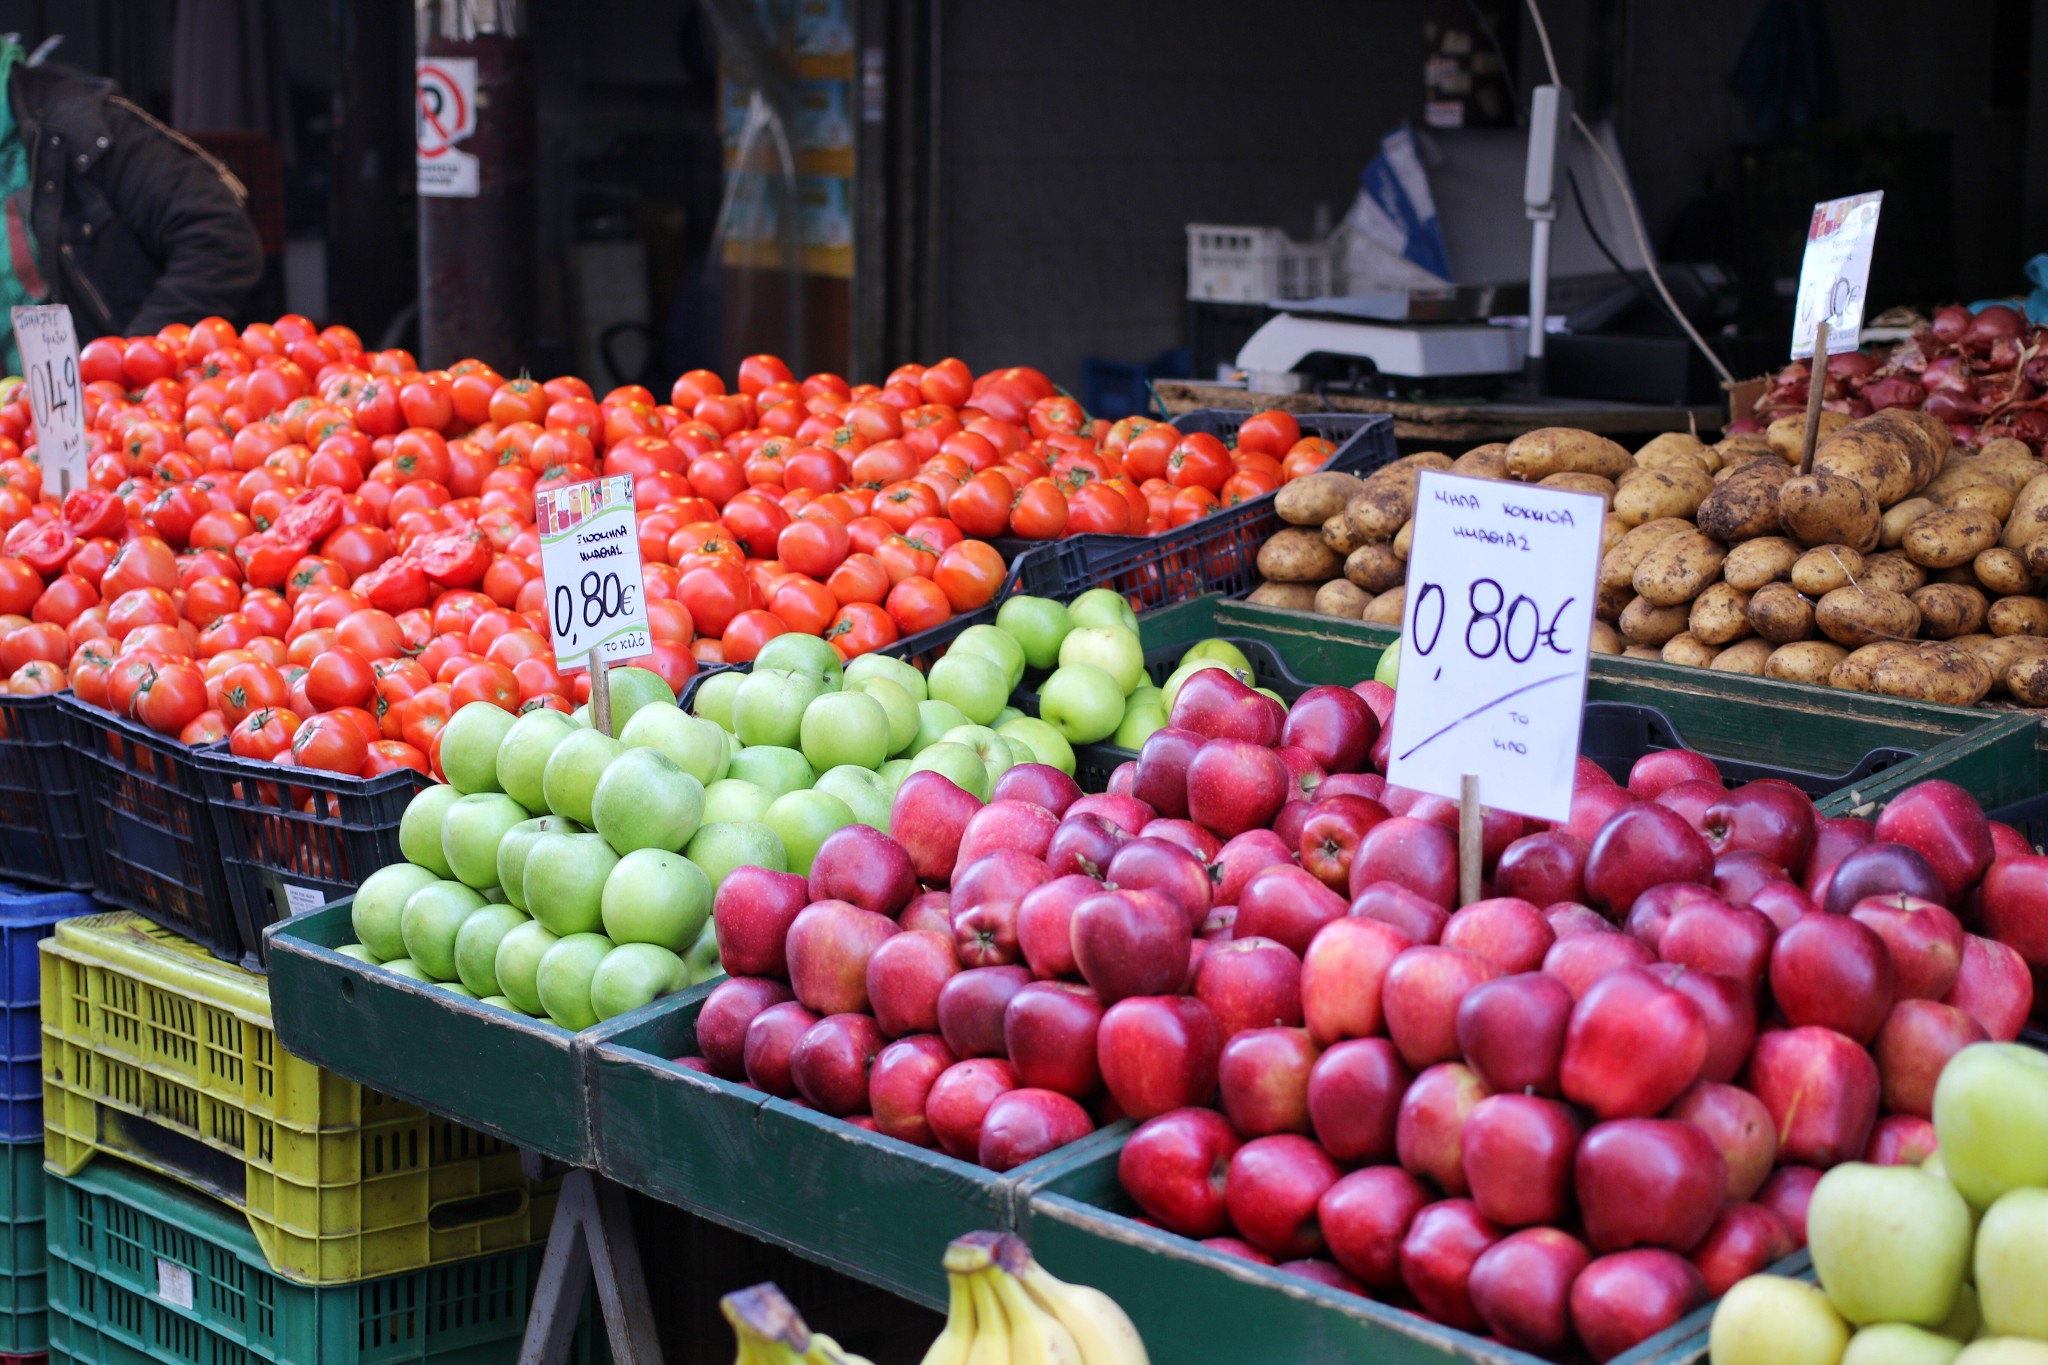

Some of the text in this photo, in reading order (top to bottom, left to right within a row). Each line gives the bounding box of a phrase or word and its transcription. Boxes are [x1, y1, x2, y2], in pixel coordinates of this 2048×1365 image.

[555, 570, 636, 646] 0,80€
[604, 632, 645, 652] το κιλό
[1509, 711, 1530, 725] ΤΟ
